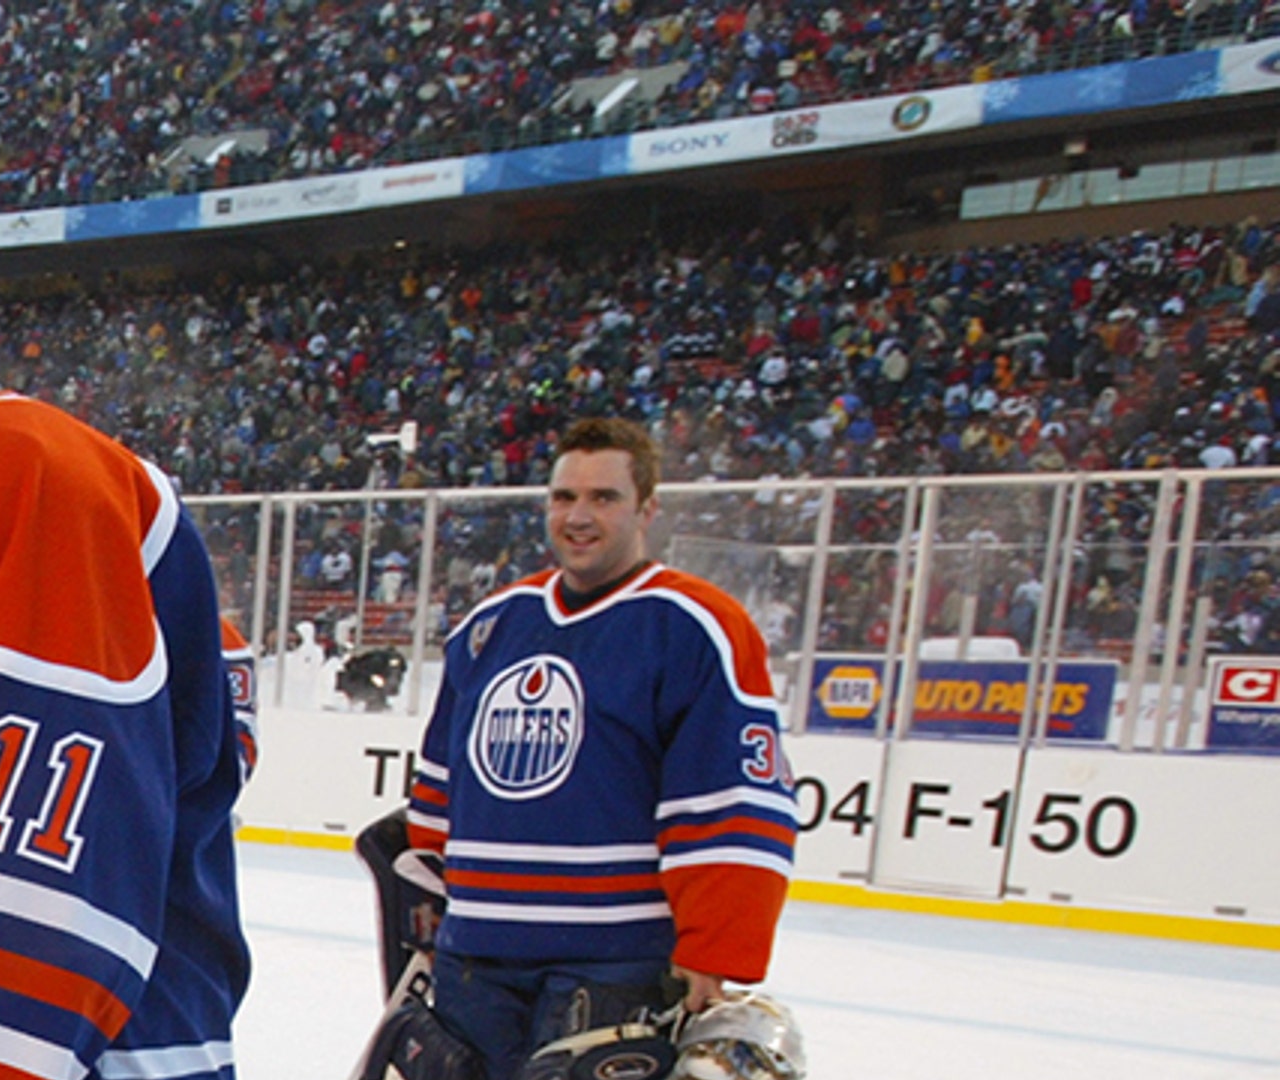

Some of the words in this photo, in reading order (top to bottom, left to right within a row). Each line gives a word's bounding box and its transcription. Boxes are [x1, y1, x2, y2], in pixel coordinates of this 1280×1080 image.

[648, 133, 731, 157] SONY
[829, 682, 870, 703] NAPA
[910, 680, 982, 711] UTO
[902, 782, 1137, 860] F-150
